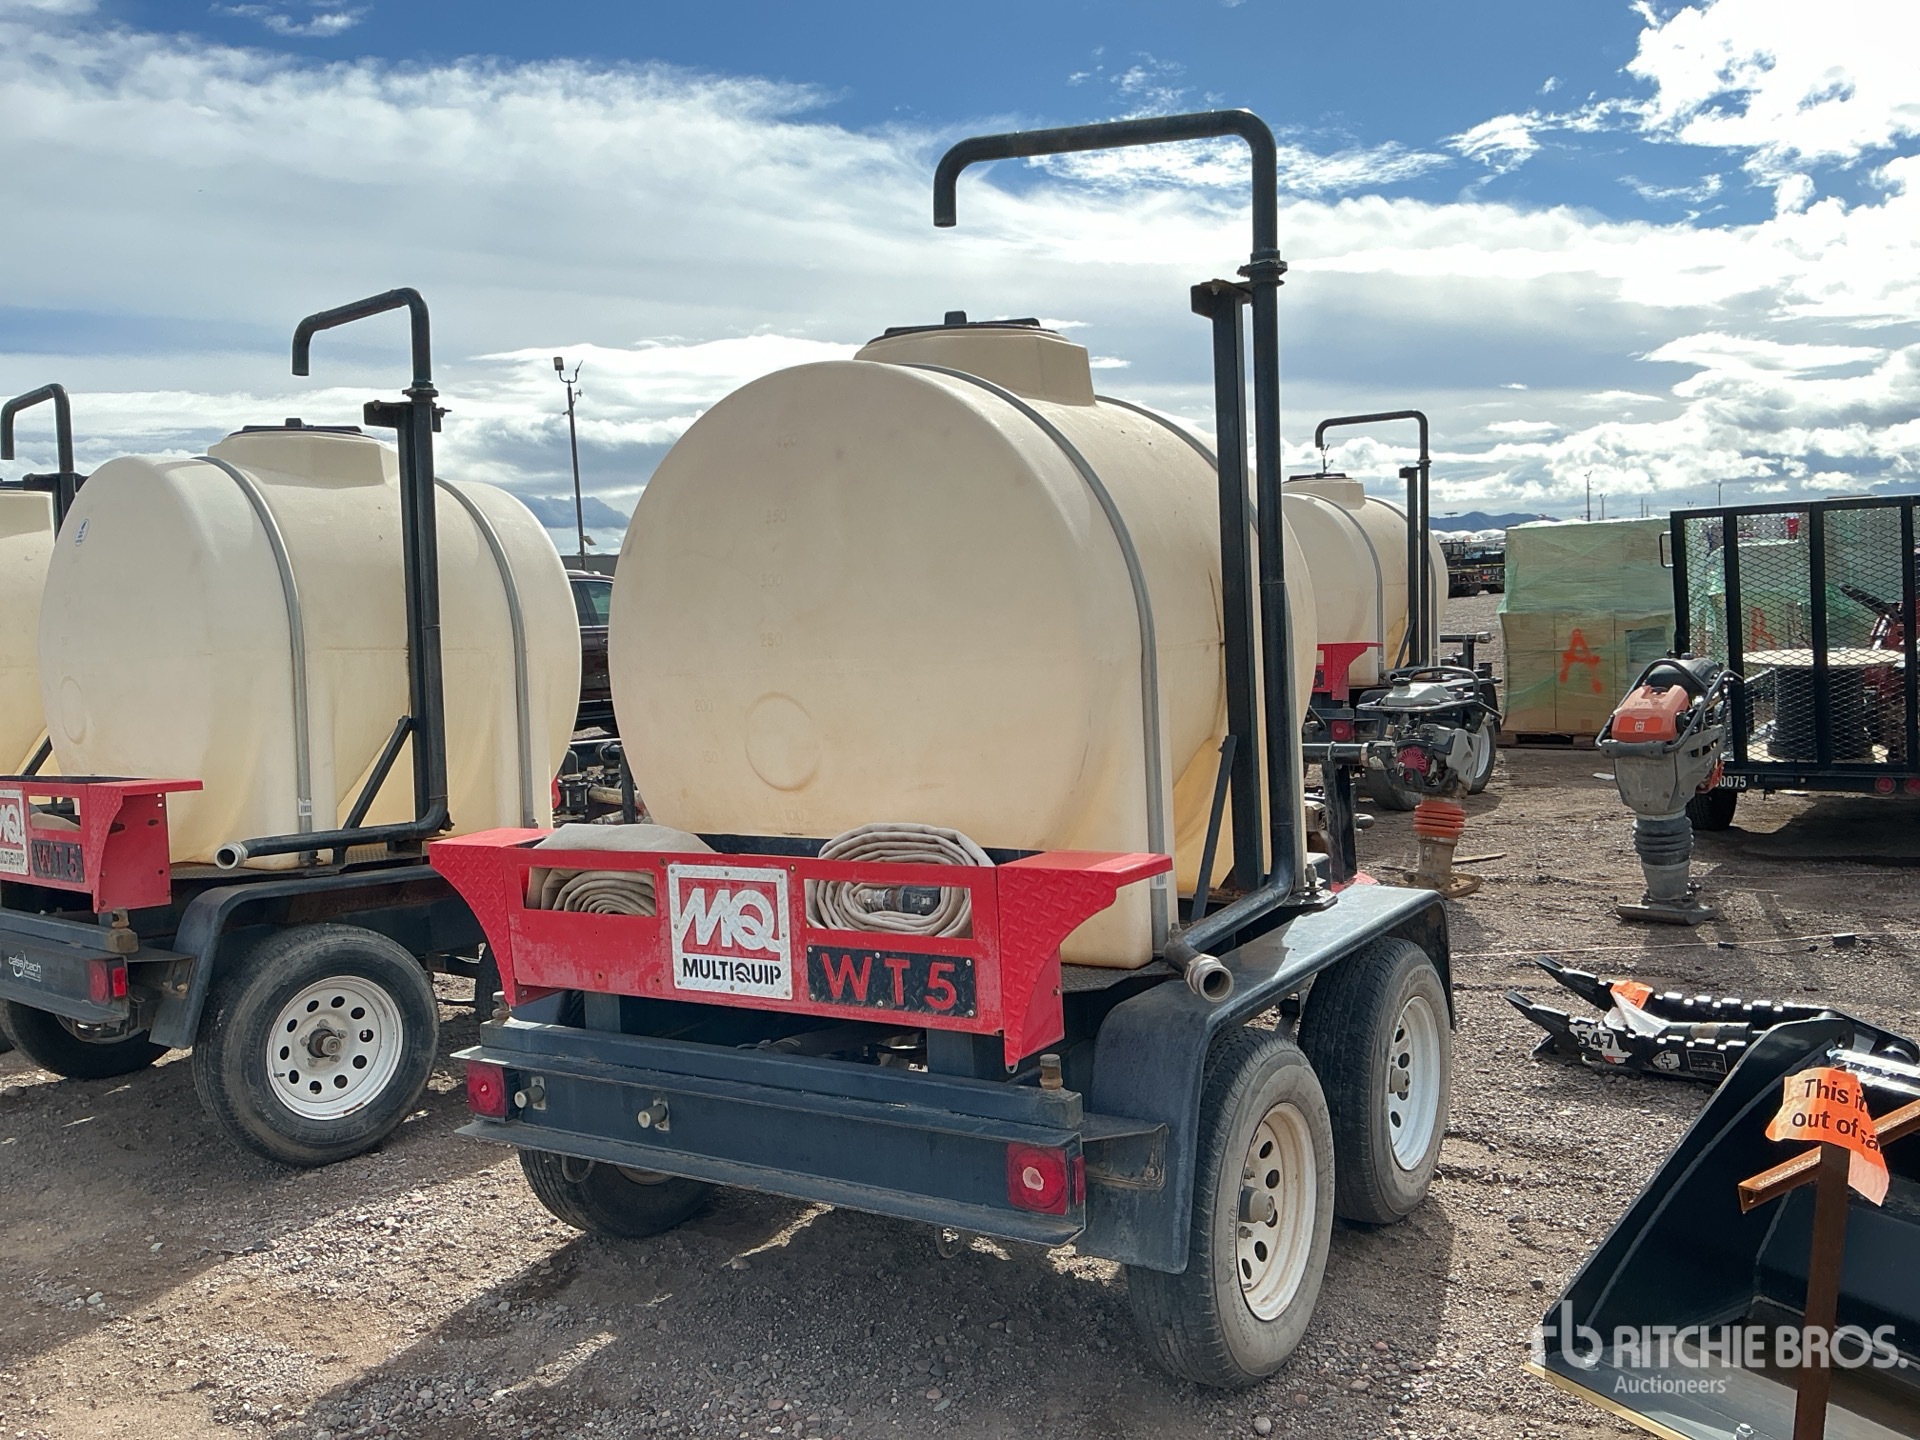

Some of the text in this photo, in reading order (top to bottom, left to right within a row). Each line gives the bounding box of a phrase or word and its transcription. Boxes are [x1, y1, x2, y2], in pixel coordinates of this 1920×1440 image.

[759, 632, 782, 648] 250
[1558, 628, 1604, 695] A
[680, 887, 781, 952] MQ
[682, 957, 782, 985] MULTIQUIP
[1576, 1030, 1614, 1049] 547
[1804, 1079, 1849, 1104] This
[1792, 1111, 1830, 1129] out
[1836, 1118, 1858, 1138] of
